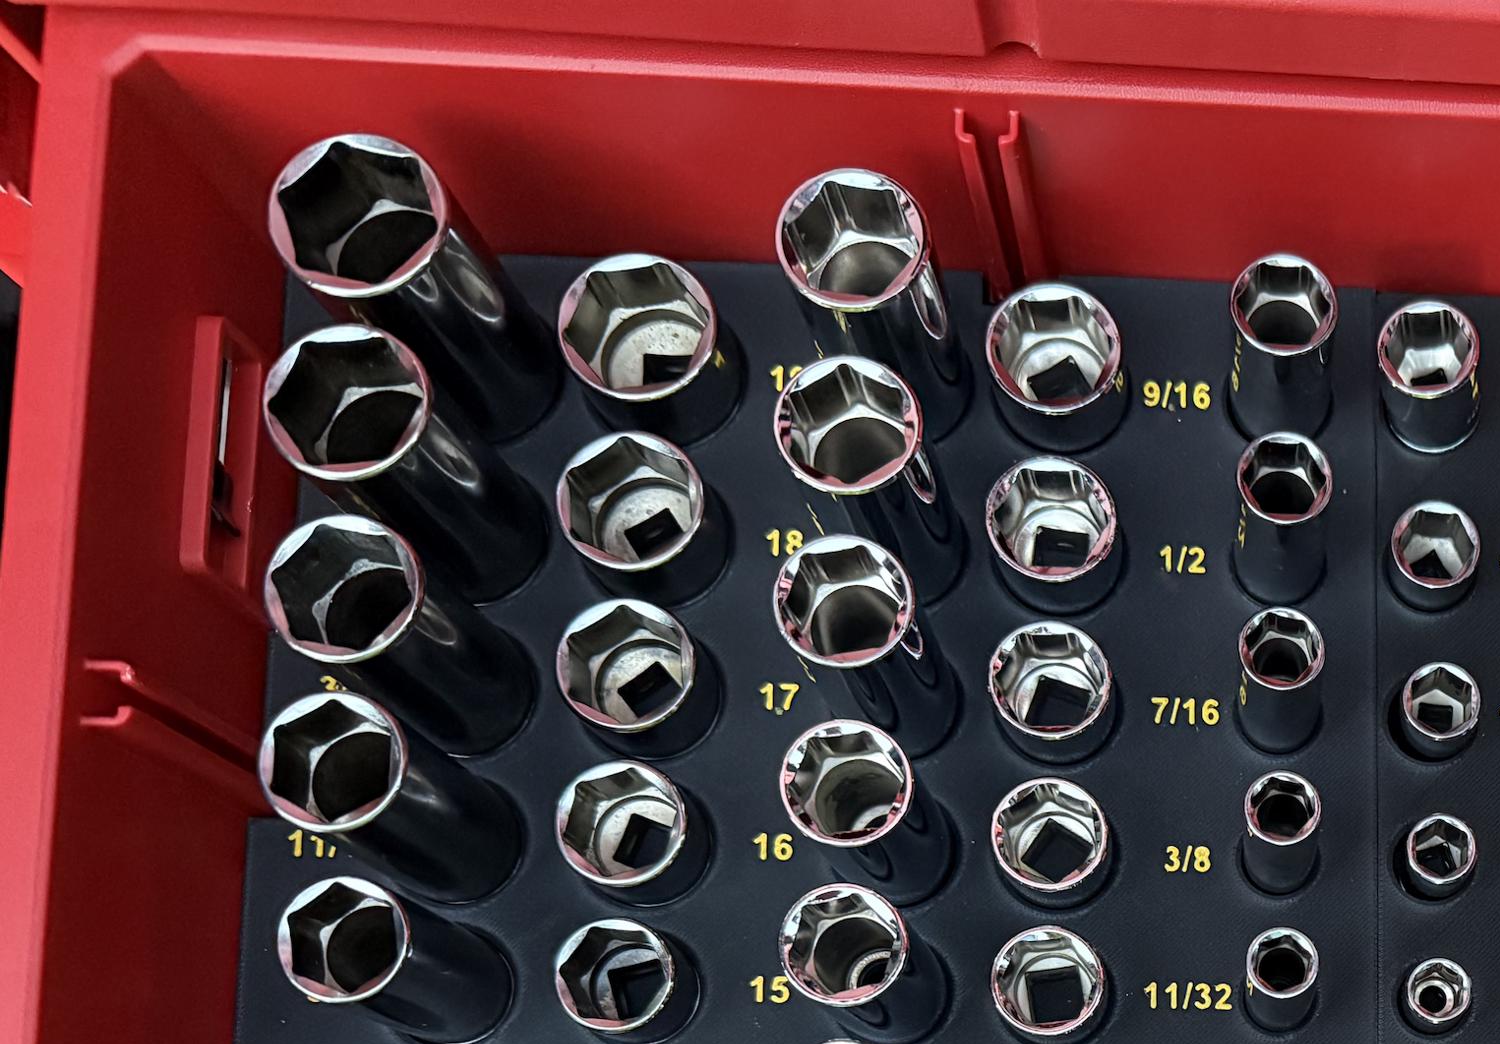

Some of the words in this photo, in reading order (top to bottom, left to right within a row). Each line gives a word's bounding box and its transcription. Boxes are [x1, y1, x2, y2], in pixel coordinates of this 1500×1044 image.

[1142, 380, 1211, 411] 9/16
[767, 529, 804, 557] 18
[1159, 545, 1206, 574] 1/2
[759, 682, 800, 711] 17
[1151, 697, 1220, 726] 7/16
[753, 832, 794, 861] 16
[1164, 846, 1212, 873] 3/8
[750, 975, 792, 1004] 15
[1144, 982, 1233, 1011] 11/32
